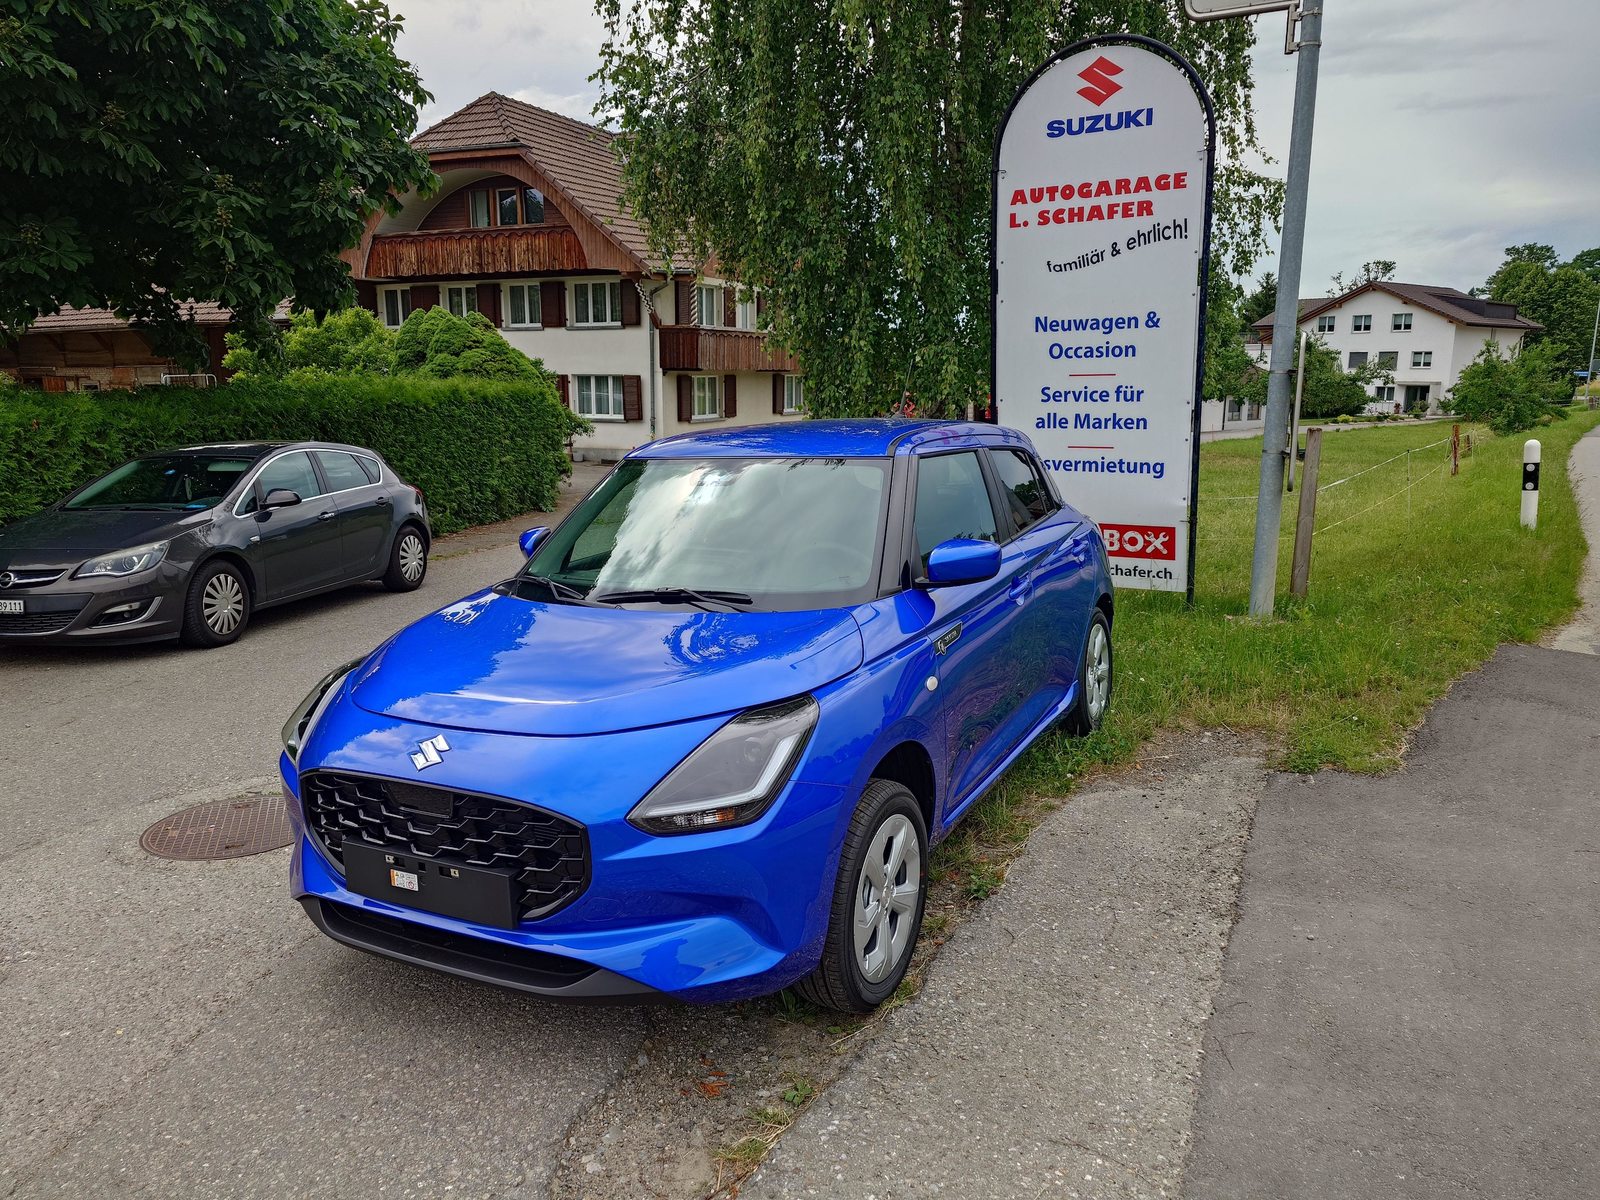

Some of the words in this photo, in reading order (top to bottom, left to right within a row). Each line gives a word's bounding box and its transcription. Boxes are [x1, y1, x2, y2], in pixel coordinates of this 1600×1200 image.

[1046, 107, 1154, 138] SUZUKI
[1010, 172, 1188, 205] AUTOGARAGE
[1009, 212, 1029, 228] L.
[1037, 200, 1154, 227] SCHAFER
[1047, 249, 1105, 273] familiär
[1110, 241, 1121, 257] &
[1126, 218, 1188, 251] ehrlich!
[1034, 316, 1139, 334] Neuwagen
[1144, 311, 1161, 328] &
[1048, 341, 1137, 359] Occasion
[1040, 386, 1110, 403] Service
[1115, 385, 1145, 403] für
[1035, 412, 1069, 429] alle
[1074, 413, 1148, 430] Marken
[1041, 456, 1165, 479] svermietung
